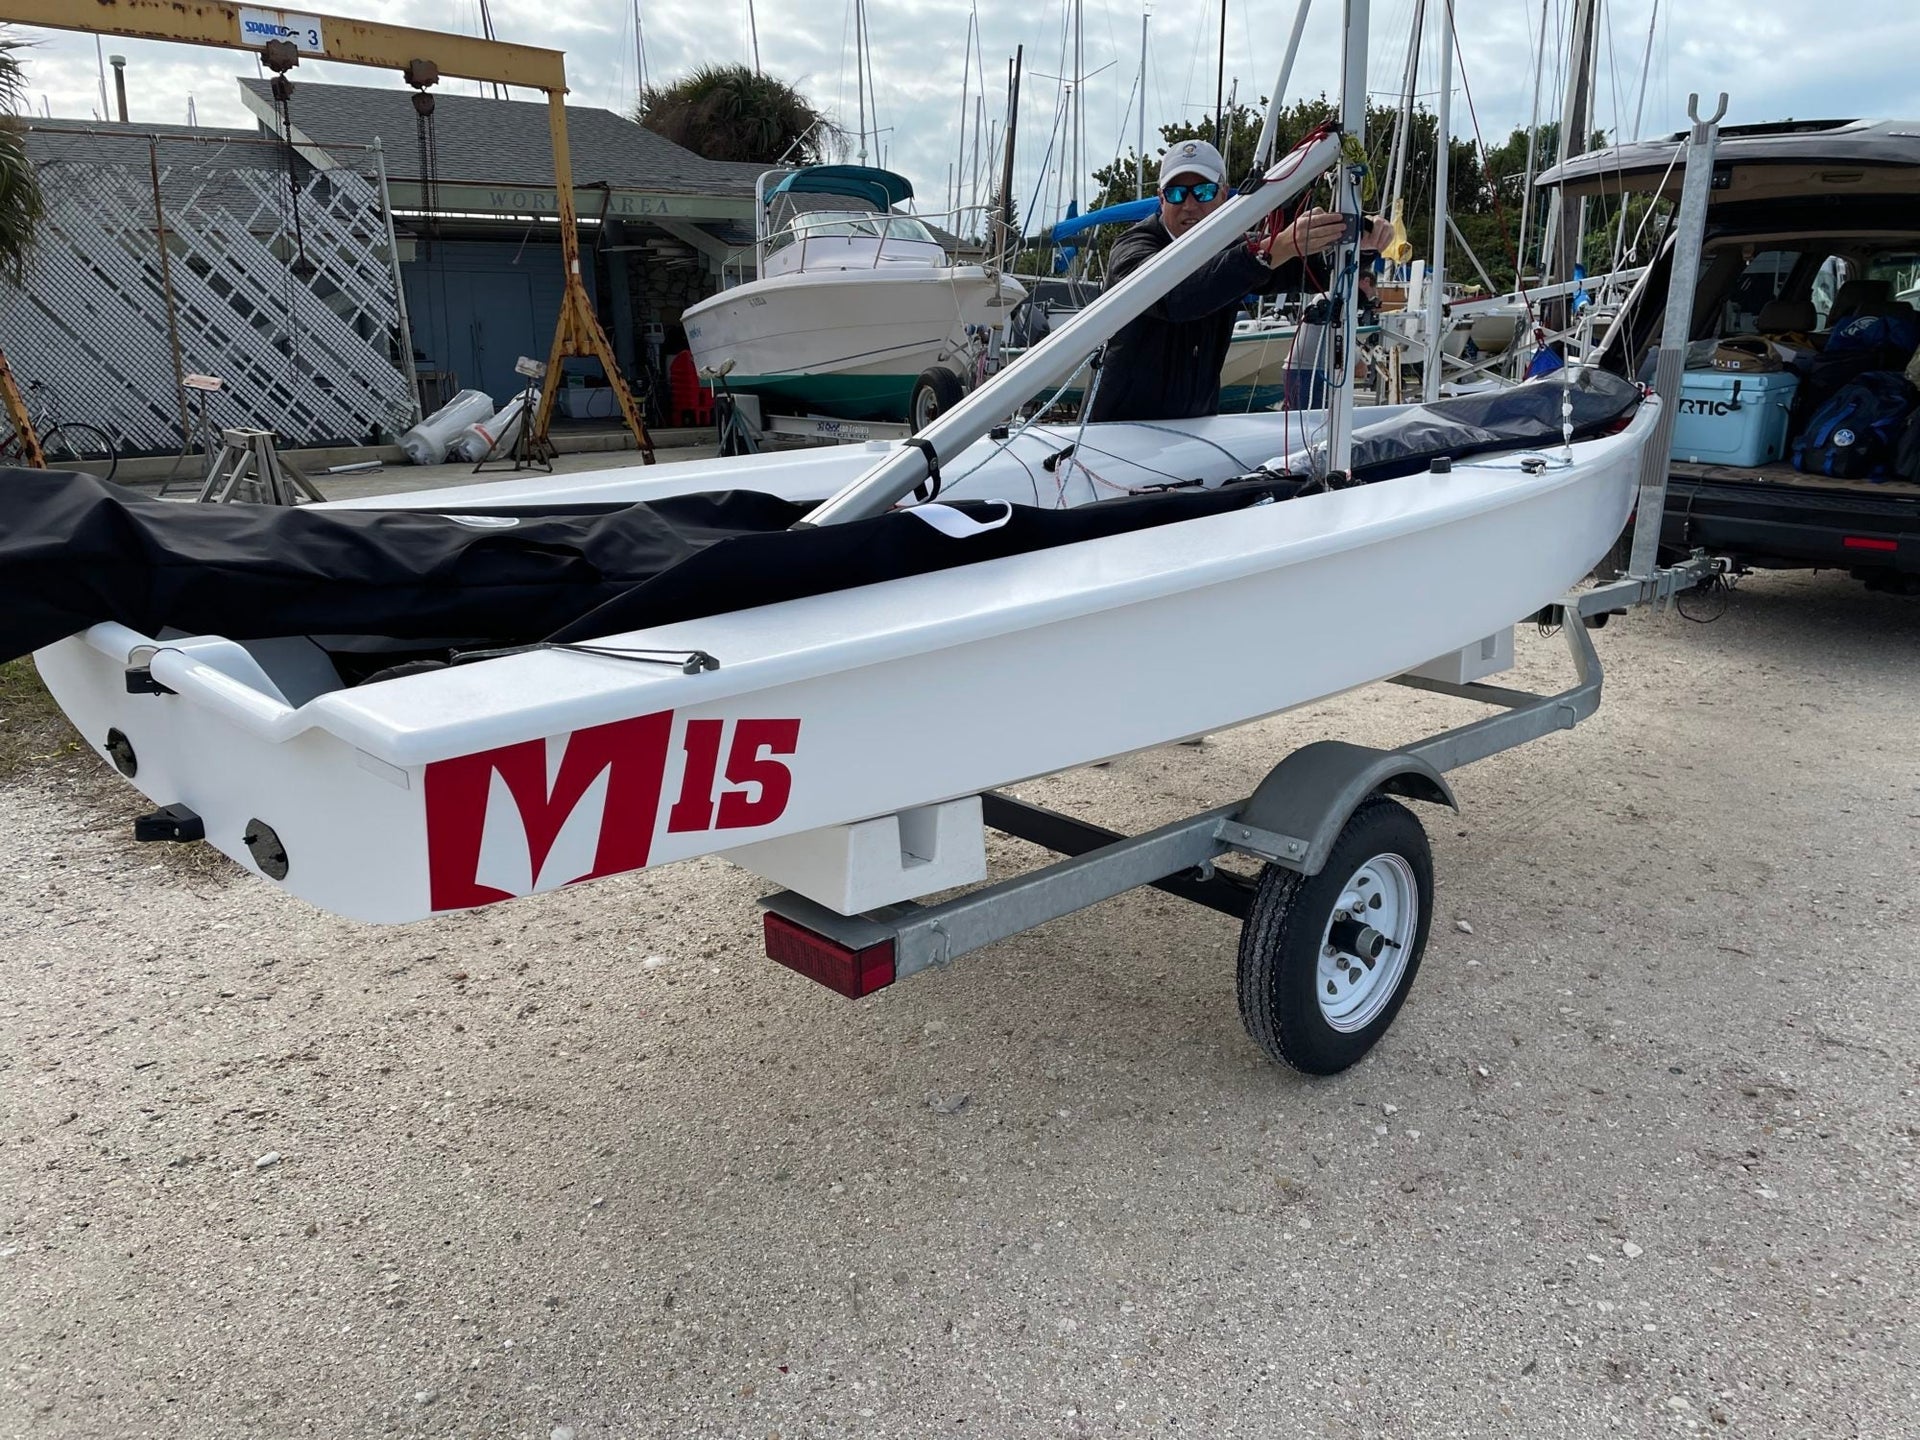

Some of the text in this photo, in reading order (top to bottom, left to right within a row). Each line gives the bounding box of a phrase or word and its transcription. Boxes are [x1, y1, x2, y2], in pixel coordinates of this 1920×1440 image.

[308, 29, 319, 46] 3
[600, 199, 669, 213] AREA
[1679, 399, 1728, 416] RTIC
